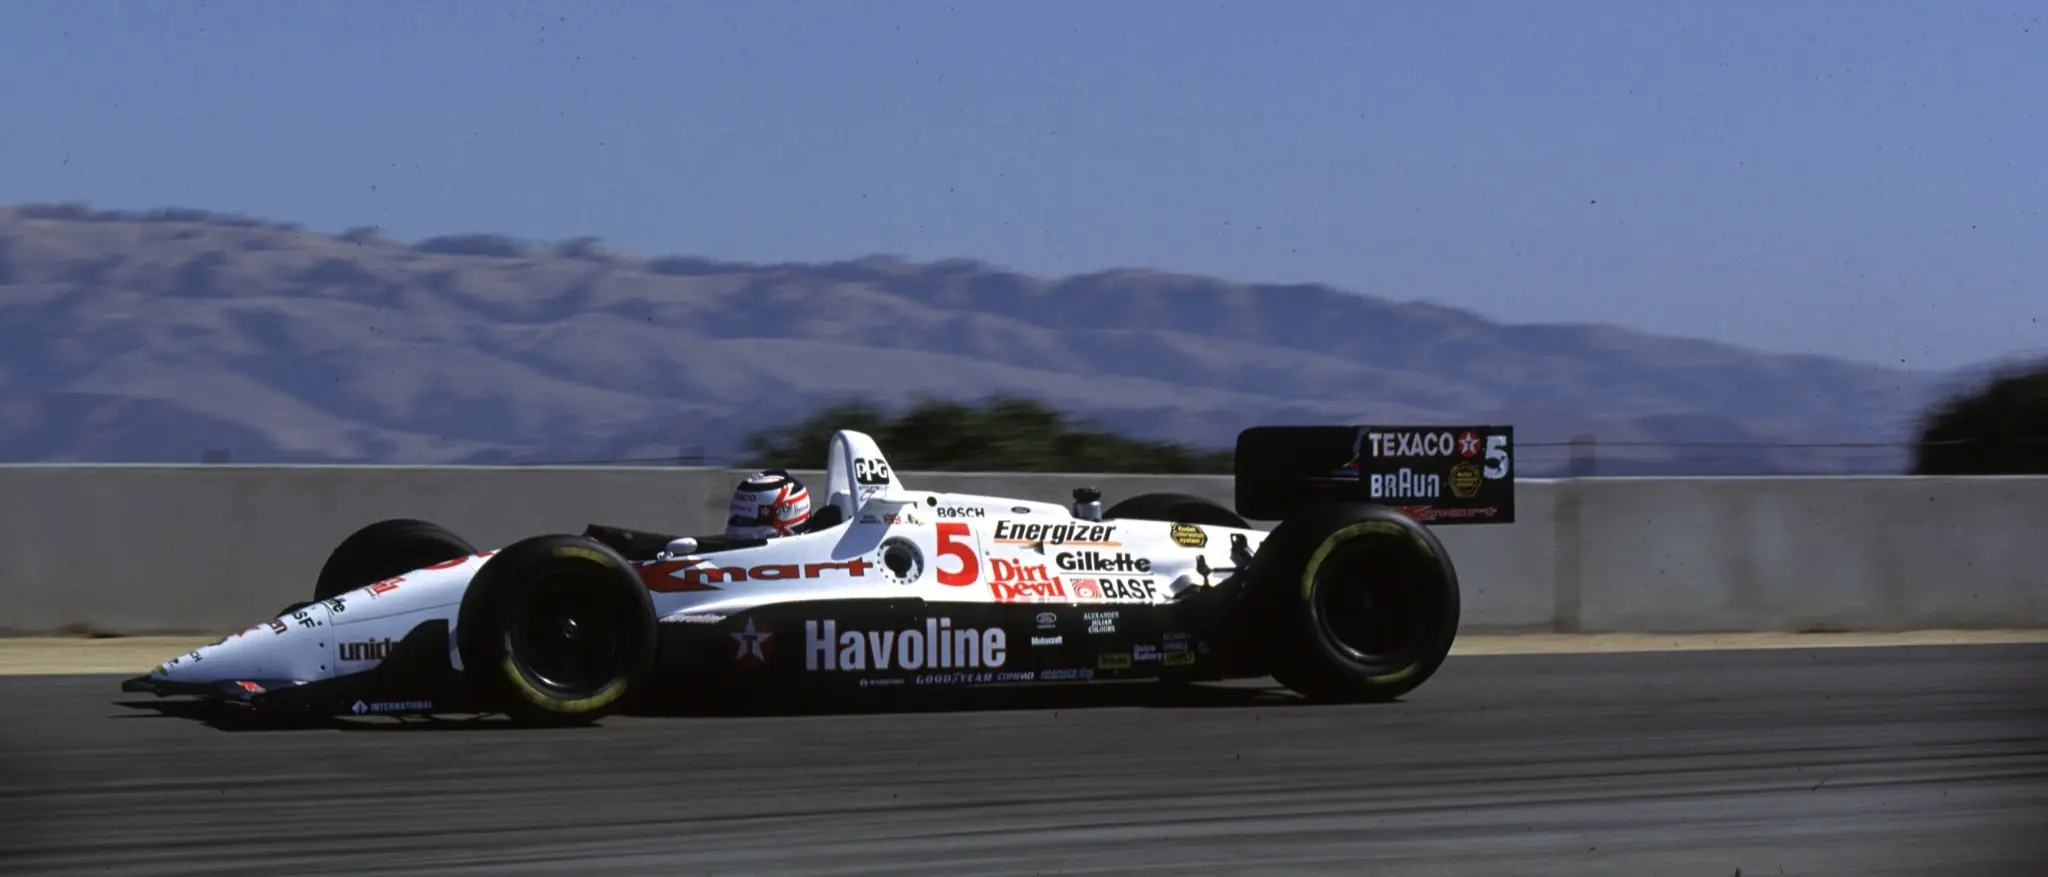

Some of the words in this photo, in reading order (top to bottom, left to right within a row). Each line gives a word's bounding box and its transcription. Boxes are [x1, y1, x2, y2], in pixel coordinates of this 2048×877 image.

[1368, 431, 1455, 457] TEXACO
[1483, 434, 1509, 479] 5
[855, 457, 888, 482] PPG
[1370, 467, 1440, 498] BRAUN
[937, 506, 985, 518] BOSCH
[994, 520, 1117, 545] Energizer
[936, 522, 979, 587] 5
[1055, 551, 1152, 573] Gillette
[637, 558, 874, 592] Kmart
[989, 558, 1048, 583] Dirt
[988, 577, 1066, 603] Devil
[1099, 579, 1157, 600] BASF
[1083, 611, 1120, 620] ALEXANDER
[1091, 619, 1112, 627] JULIAN
[1088, 625, 1115, 634] COLOURS
[804, 617, 1006, 671] Havoline
[915, 672, 993, 685] GOODYEAR
[370, 700, 432, 712] INTERNATIONAL
